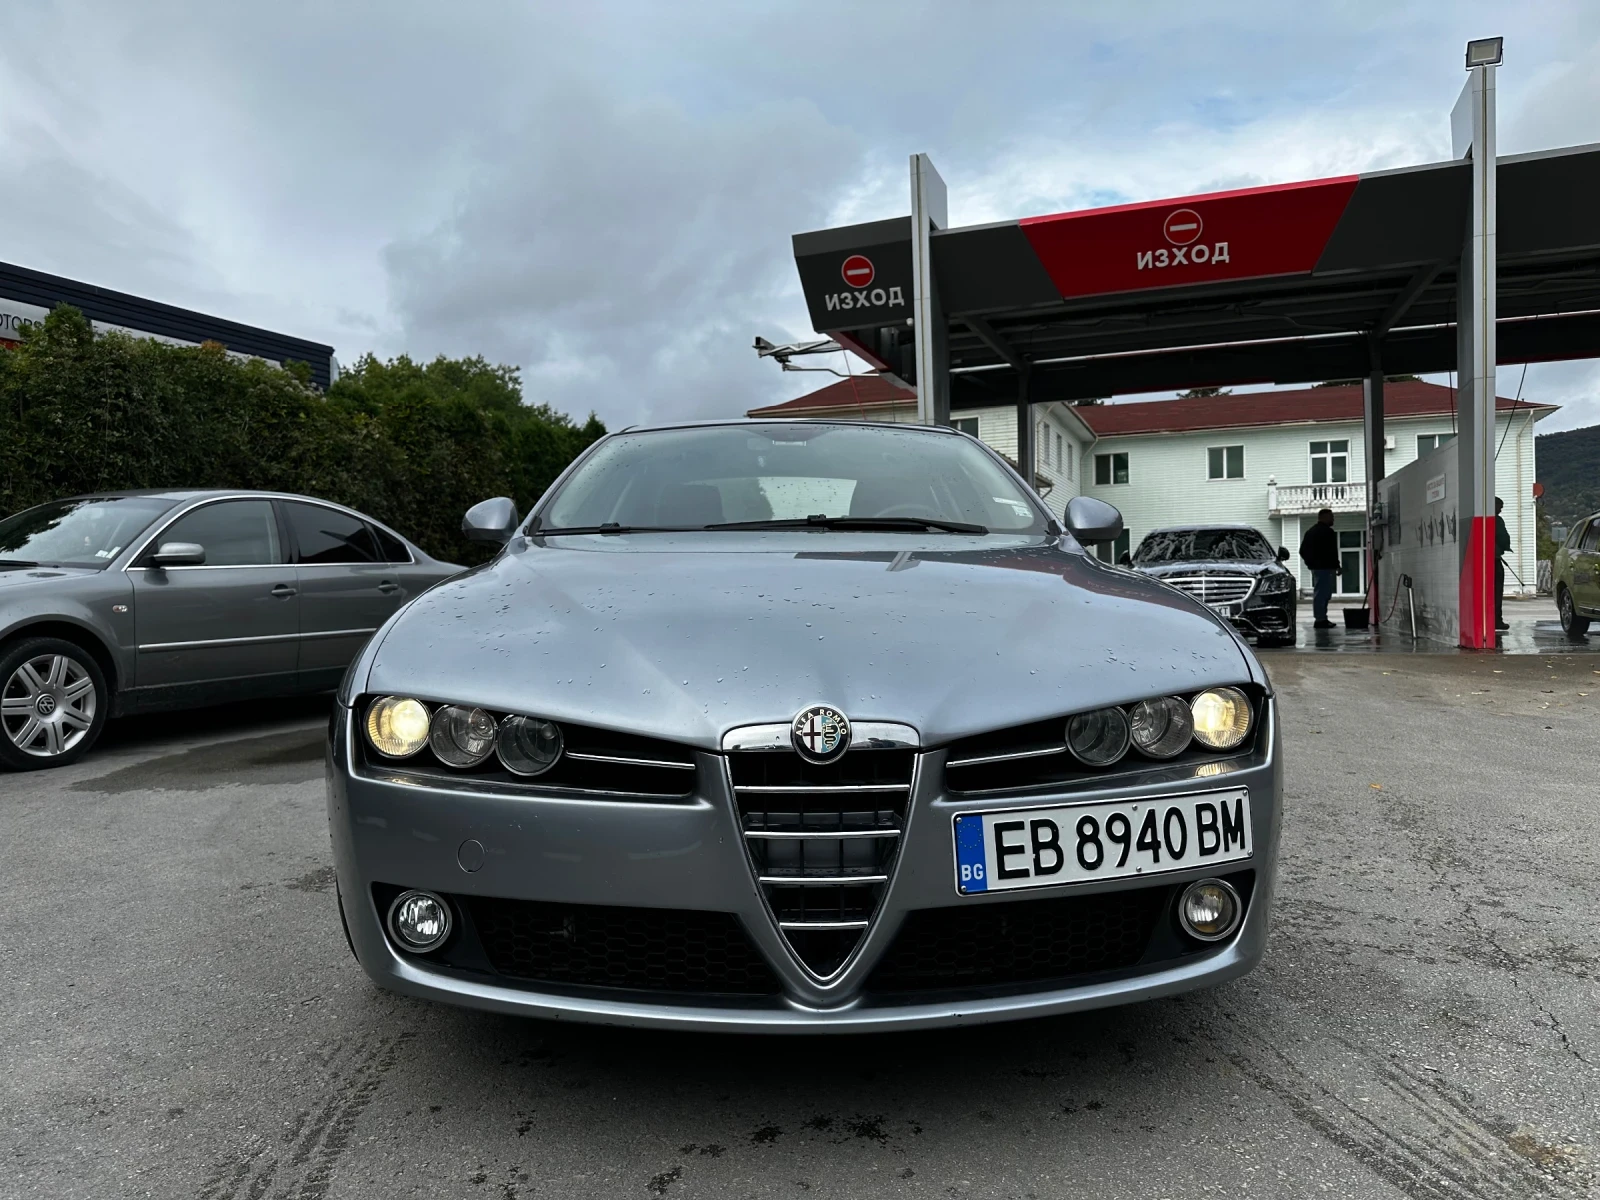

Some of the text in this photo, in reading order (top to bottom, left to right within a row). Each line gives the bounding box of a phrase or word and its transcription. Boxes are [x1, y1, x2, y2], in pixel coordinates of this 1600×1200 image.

[1136, 242, 1230, 270] ИЗХОД
[824, 286, 905, 311] ИЗХОД
[796, 709, 847, 736] ALFA ROMEO
[994, 798, 1246, 880] EB 8940 BM
[961, 863, 984, 882] BG
